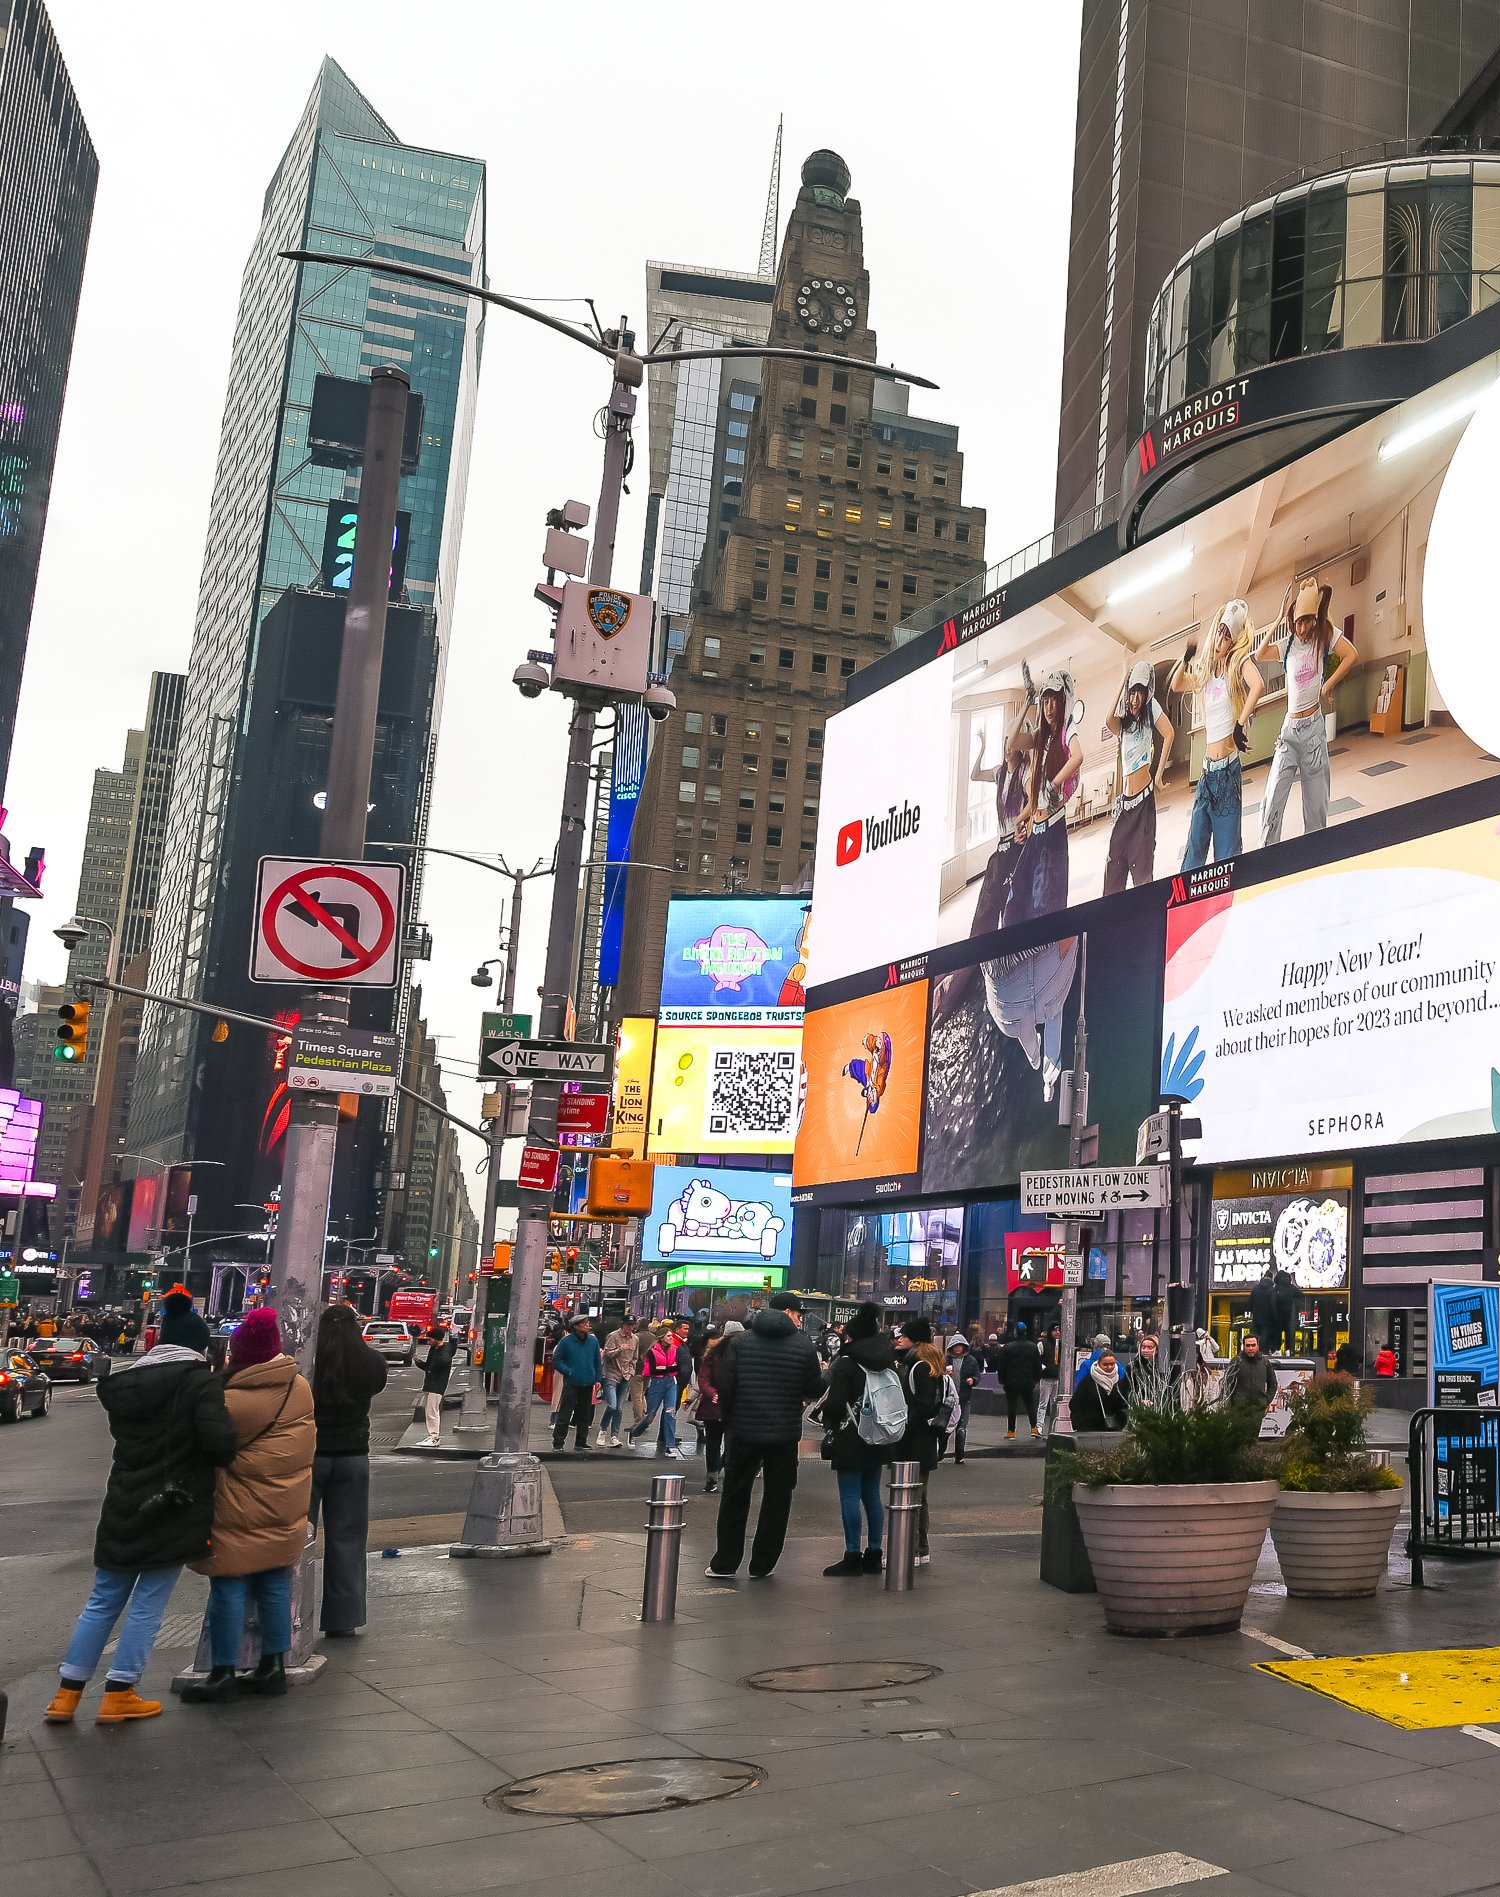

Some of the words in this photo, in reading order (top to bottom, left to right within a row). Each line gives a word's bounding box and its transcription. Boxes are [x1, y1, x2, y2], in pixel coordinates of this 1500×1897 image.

[1164, 379, 1249, 434] MARRIOTT
[1162, 407, 1236, 455] MARQUIS
[590, 597, 628, 610] DEPARTMENT
[599, 592, 622, 600] POLICE
[962, 590, 1007, 625] MARRIOTT
[961, 607, 1001, 640] MARQUIS
[865, 799, 921, 853] YouTube
[1190, 862, 1235, 885] MARRIOTT
[1189, 876, 1229, 898] MARQUIS
[1281, 957, 1333, 988] Happy
[1335, 948, 1373, 977] New
[1378, 933, 1423, 967] Year!
[1223, 1008, 1244, 1028] We
[1245, 1001, 1283, 1026] asked
[1285, 990, 1350, 1017] members
[1353, 982, 1371, 1005] of
[1371, 981, 1398, 1001] our
[1400, 960, 1497, 995] community
[501, 1018, 513, 1027] TO
[665, 1011, 703, 1021] SOURCE
[706, 1011, 762, 1021] SPONGEBOB
[489, 1030, 496, 1038] W
[497, 1030, 511, 1038] 45
[1215, 1033, 1253, 1058] about
[1255, 1027, 1287, 1051] their
[1289, 1017, 1330, 1050] hopes
[1333, 1014, 1355, 1039] for
[1357, 1008, 1391, 1033] 2023
[1394, 1004, 1423, 1027] and
[298, 1040, 335, 1053] Times
[337, 1044, 382, 1058] Square
[295, 1053, 359, 1069] Pedestrian
[361, 1060, 392, 1072] Plaza
[501, 1051, 539, 1067] ONE
[558, 1053, 598, 1070] WAY
[559, 1107, 580, 1115] nytime
[567, 1098, 595, 1106] STANDING
[620, 1096, 642, 1109] LION
[616, 1110, 644, 1125] KING
[1151, 1117, 1164, 1132] ZONE
[1308, 1111, 1385, 1137] SEPHORA
[1026, 1175, 1090, 1190] PEDESTRIAN
[1093, 1173, 1120, 1187] FLOW
[1123, 1172, 1150, 1186] ZONE
[1251, 1167, 1310, 1189] INVICTA
[1026, 1194, 1052, 1207] KEEP
[1055, 1191, 1095, 1206] MOVING
[1232, 1210, 1272, 1226] INVICTA
[1214, 1250, 1235, 1265] LAS
[1235, 1248, 1271, 1264] VEGAS
[1450, 1327, 1460, 1339] IN
[1460, 1321, 1482, 1337] TIMES
[1452, 1334, 1482, 1351] SQUARE
